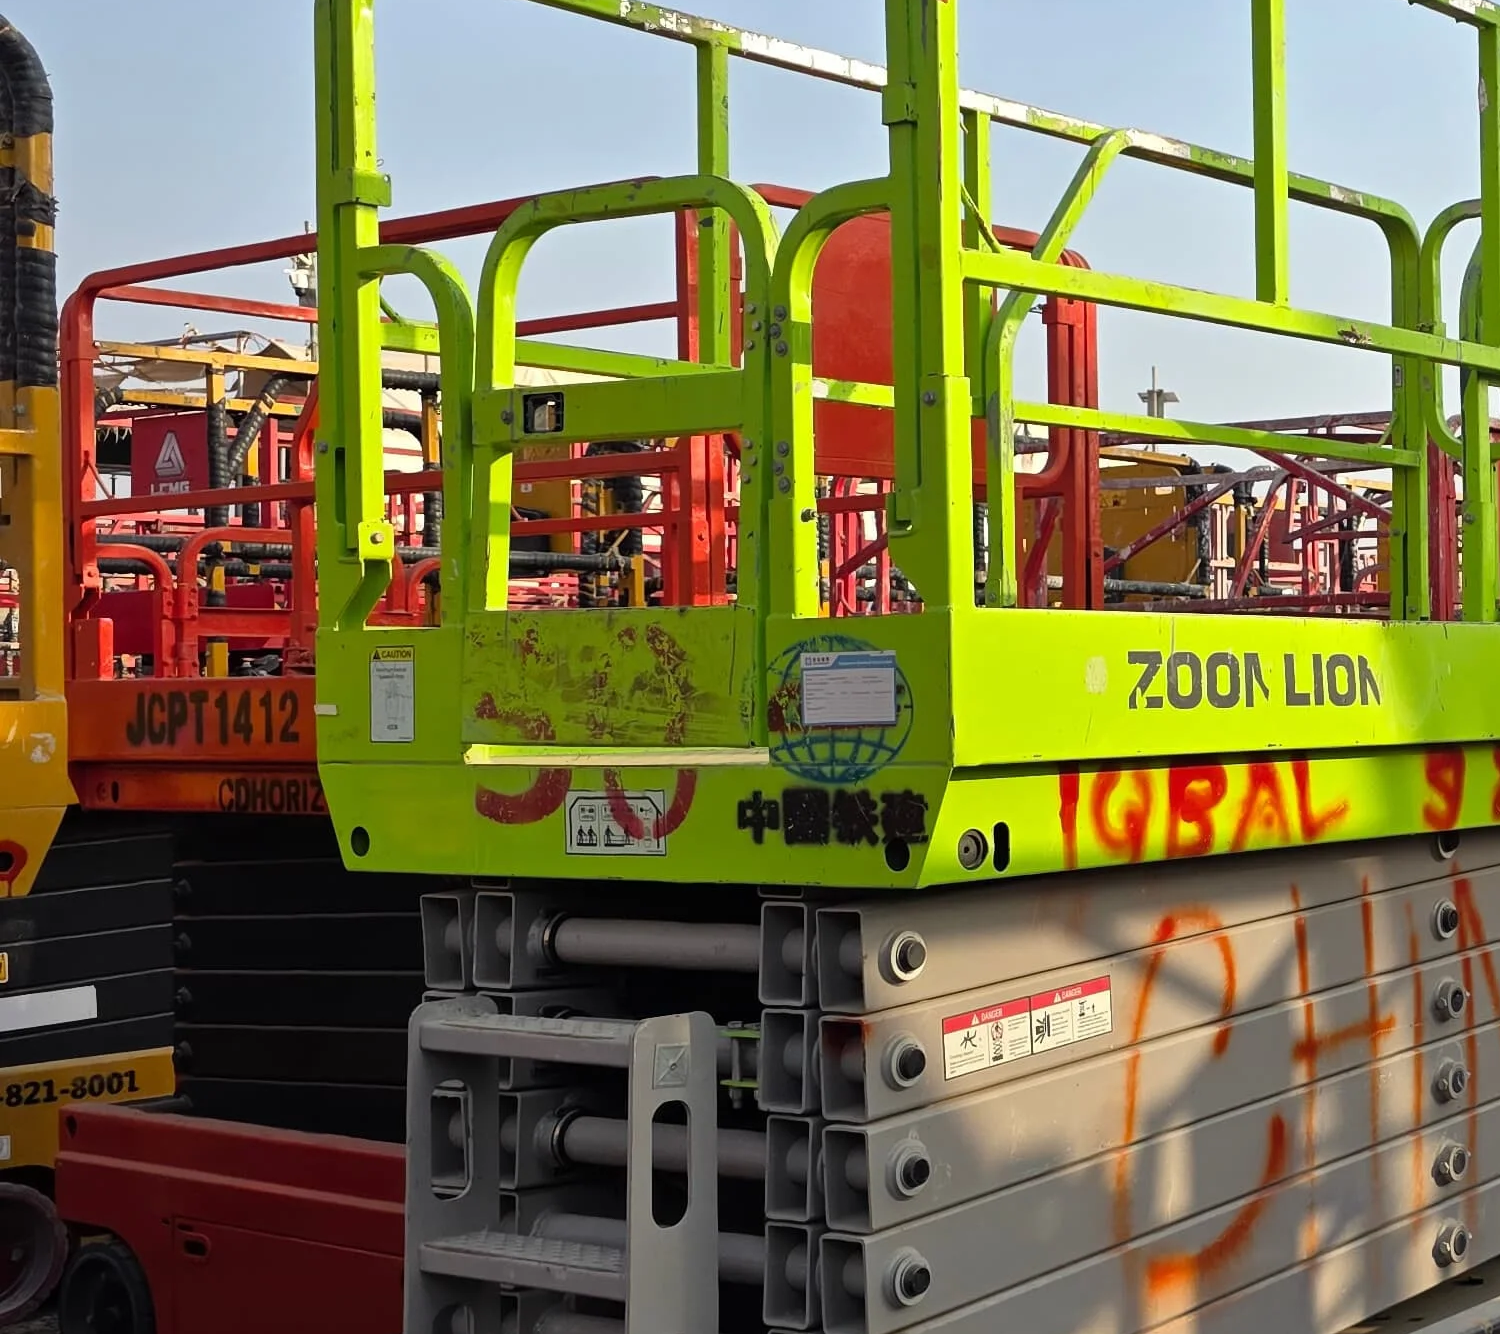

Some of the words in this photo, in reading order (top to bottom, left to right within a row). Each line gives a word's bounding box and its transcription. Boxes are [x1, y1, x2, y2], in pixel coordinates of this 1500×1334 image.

[381, 650, 412, 659] CAUTION
[126, 690, 299, 747] JCPT1412
[1058, 748, 1349, 870] IQBAL
[1062, 987, 1083, 1000] DANGER
[981, 1008, 1003, 1022] DANGER
